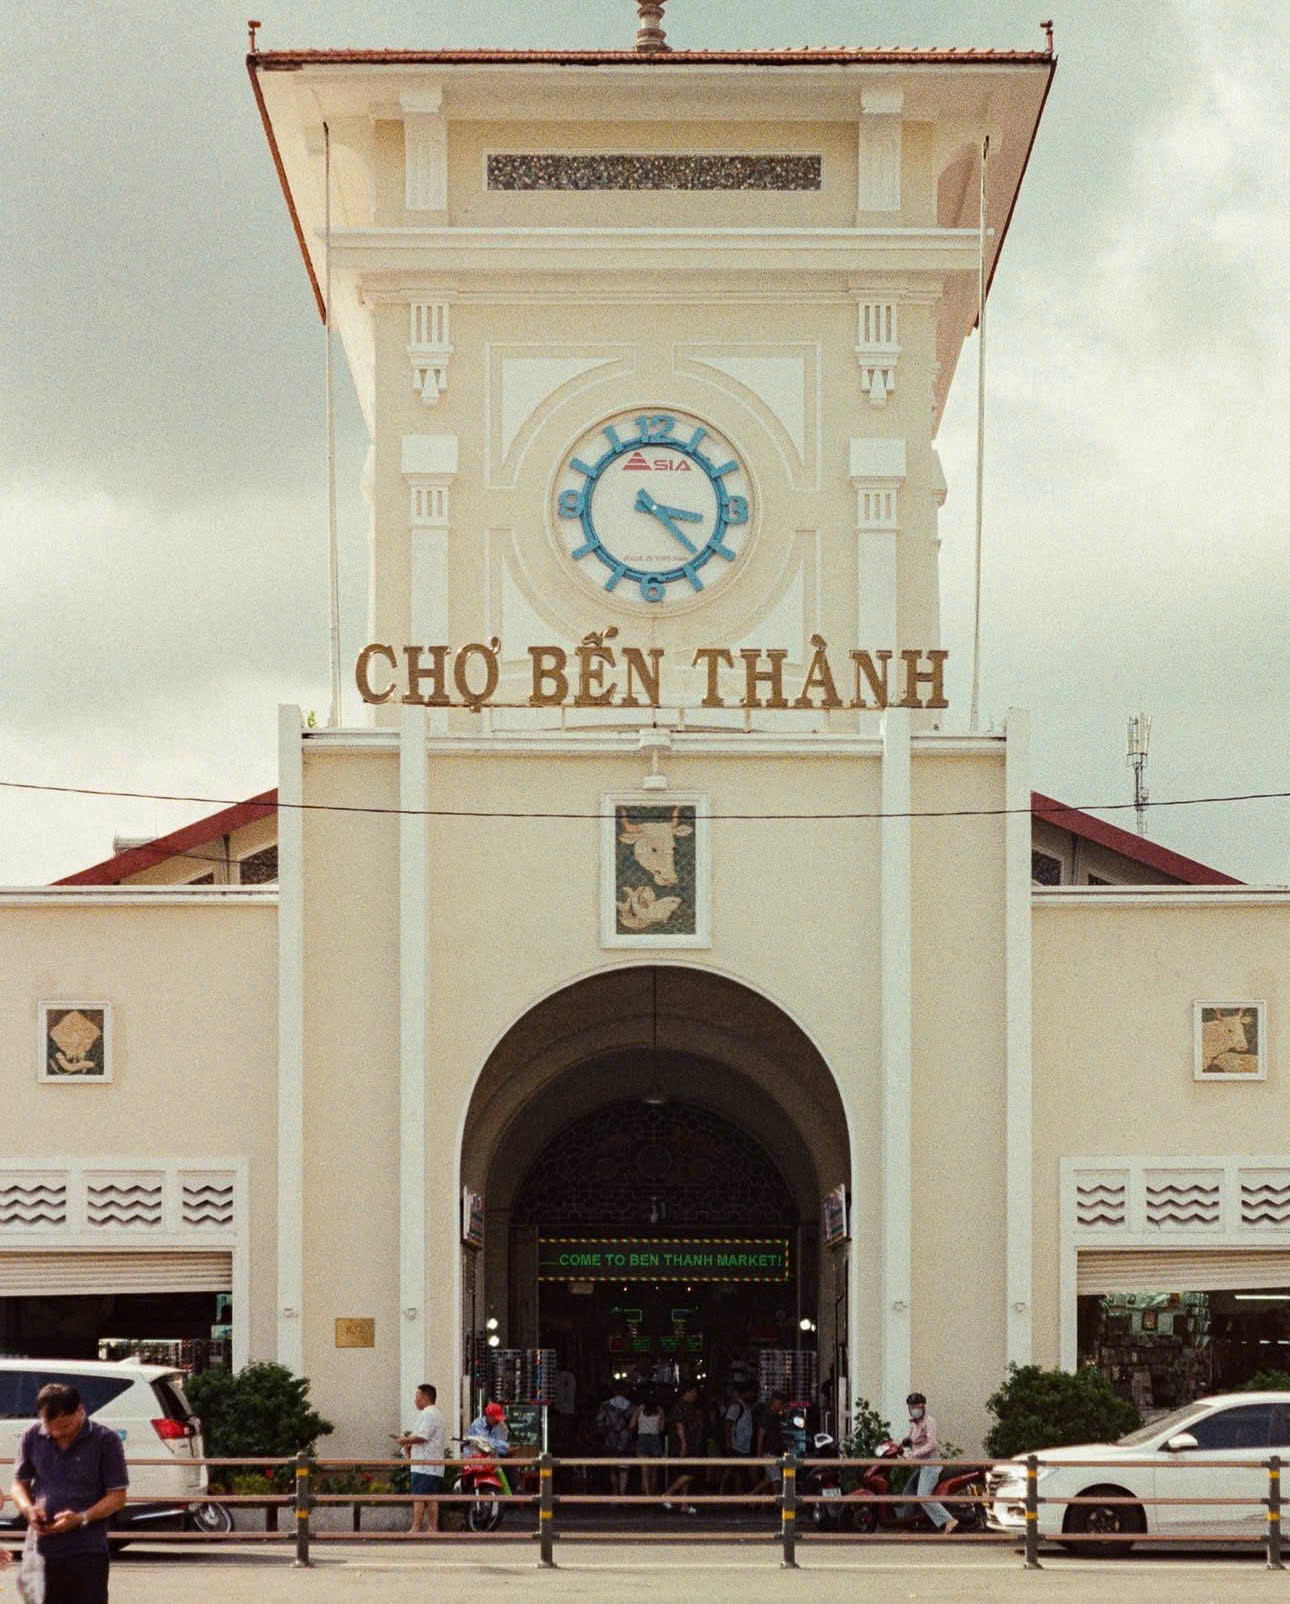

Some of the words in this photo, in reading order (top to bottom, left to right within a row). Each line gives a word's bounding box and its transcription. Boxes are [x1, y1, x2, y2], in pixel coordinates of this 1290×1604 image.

[635, 415, 676, 443] 12
[558, 489, 585, 519] 9
[722, 495, 749, 525] 3
[639, 574, 666, 602] 6
[355, 636, 500, 713] CHỢ
[528, 626, 664, 707] BẾN
[692, 633, 949, 709] THÀNH
[559, 1253, 600, 1266] COME
[606, 1253, 625, 1266] TO
[629, 1253, 659, 1266] BEN
[663, 1253, 713, 1267] THANH
[717, 1253, 783, 1267] MARKET!
